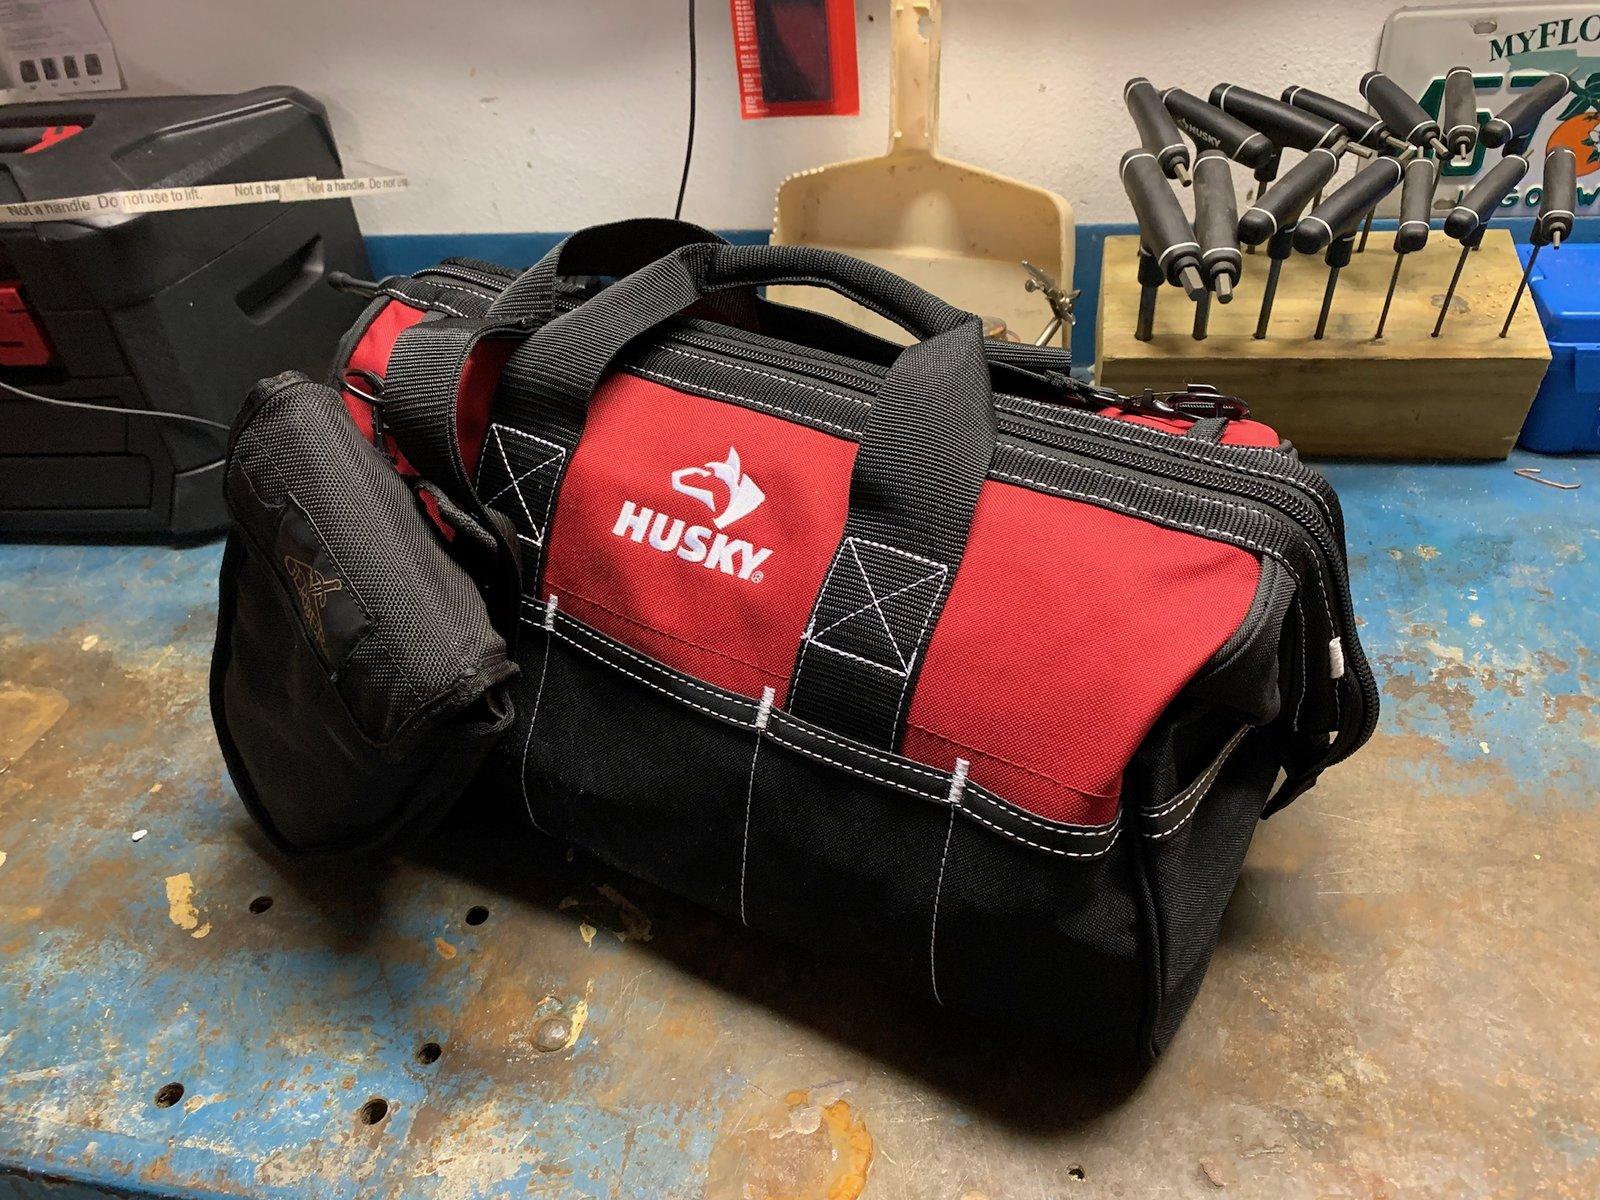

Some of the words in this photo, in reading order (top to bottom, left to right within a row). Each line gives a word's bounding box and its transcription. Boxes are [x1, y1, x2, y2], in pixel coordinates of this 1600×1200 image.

[1189, 123, 1221, 148] HUSKY
[234, 184, 254, 196] Not
[256, 185, 262, 195] a
[327, 182, 333, 193] a
[369, 177, 381, 190] Do
[7, 203, 33, 216] Not
[34, 205, 43, 214] a
[97, 195, 119, 209] Do
[122, 191, 144, 207] not
[147, 193, 168, 204] use
[171, 189, 183, 202] to
[612, 500, 774, 580] HUSKY
